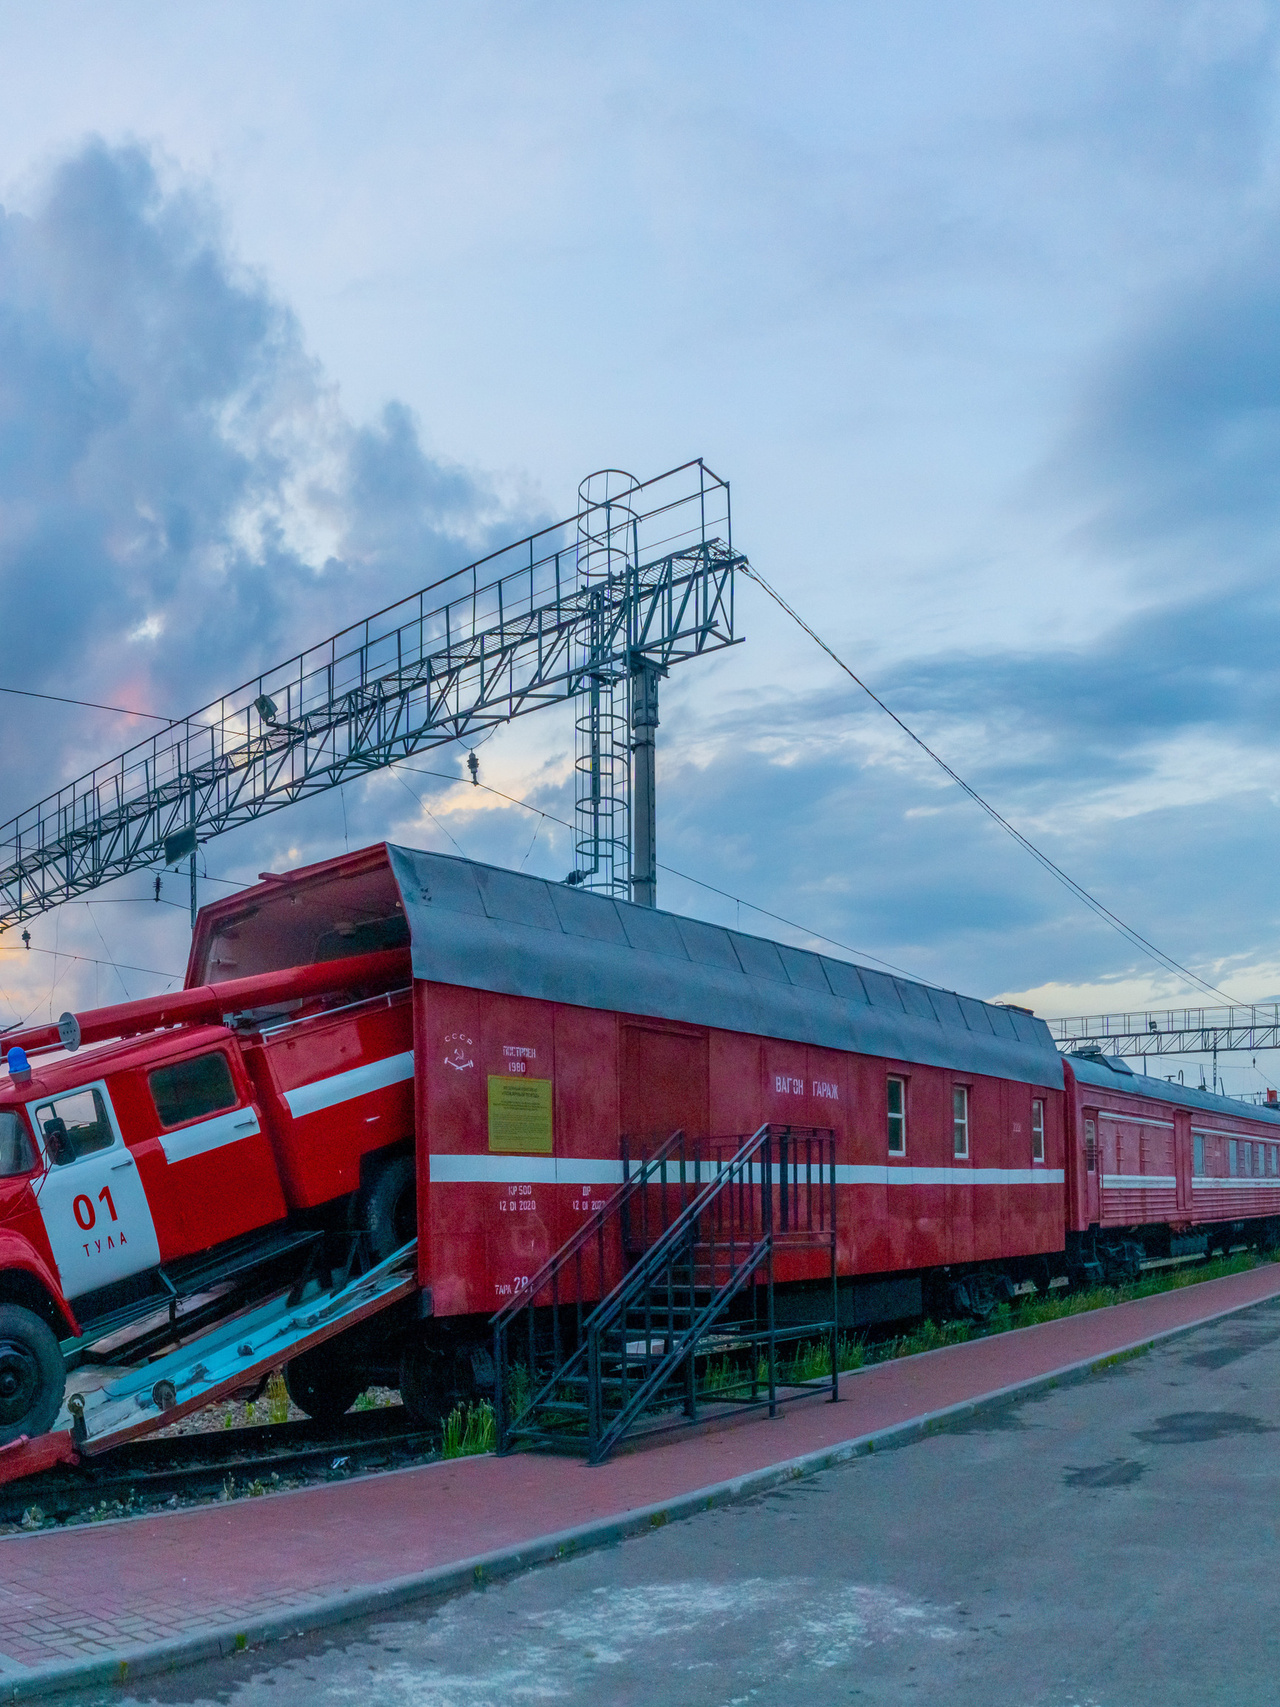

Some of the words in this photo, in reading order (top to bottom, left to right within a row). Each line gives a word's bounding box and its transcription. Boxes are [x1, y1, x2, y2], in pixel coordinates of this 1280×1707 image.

[444, 1032, 473, 1045] СССР
[502, 1045, 536, 1058] ПОСТРОЕН
[508, 1061, 526, 1073] 1980
[775, 1076, 804, 1095] ВАГОН
[812, 1081, 839, 1100] ГАРАЖ
[519, 1185, 532, 1195] 500
[72, 1185, 118, 1231] 01
[82, 1231, 128, 1258] ТУЛА
